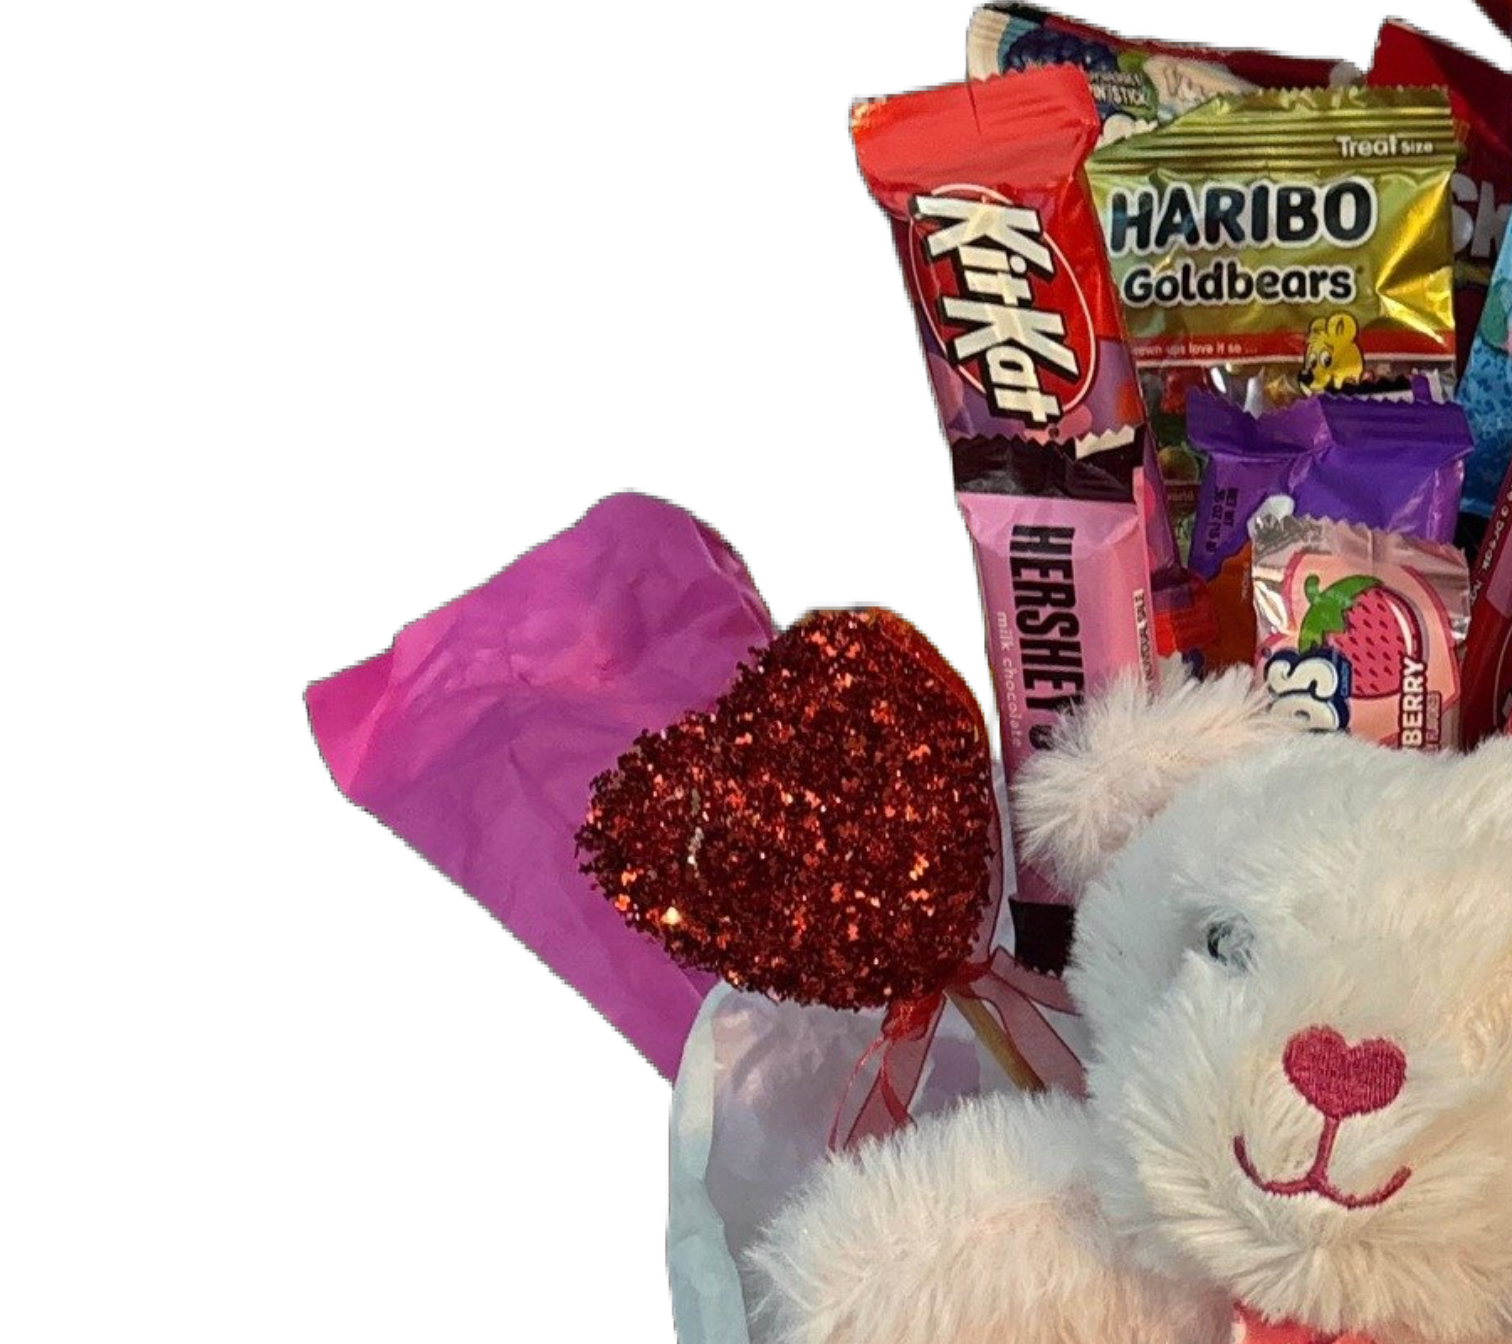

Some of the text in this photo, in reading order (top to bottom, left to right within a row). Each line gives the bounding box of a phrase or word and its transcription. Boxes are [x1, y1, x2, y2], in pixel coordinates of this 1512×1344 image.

[1335, 134, 1398, 158] Treat
[1108, 178, 1376, 254] HARIBO
[1122, 258, 1357, 306] Goldbears
[997, 610, 1012, 653] milk
[1401, 657, 1424, 748] BERRY
